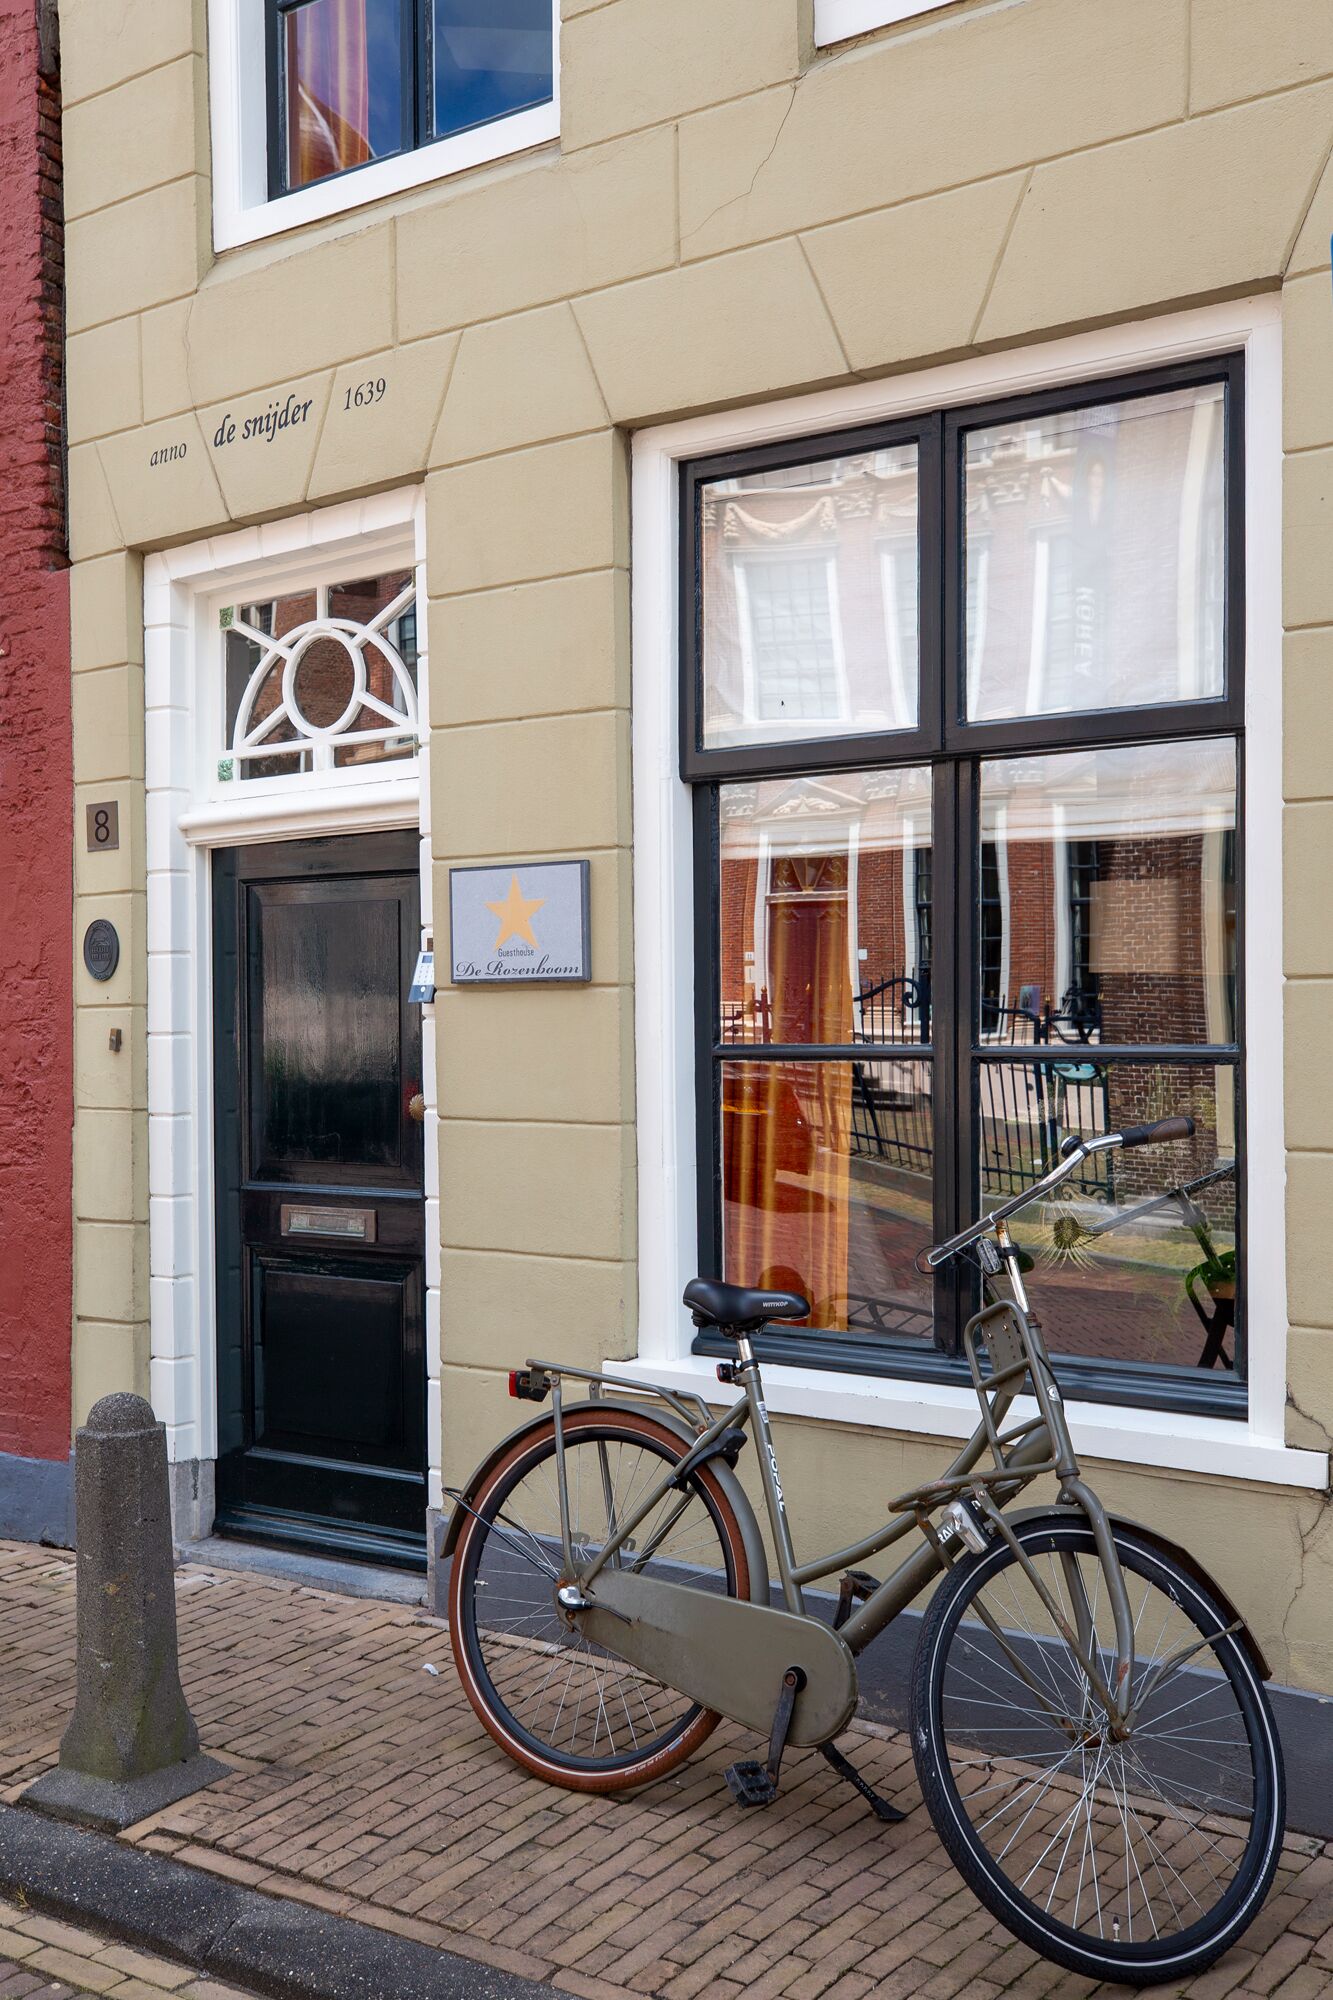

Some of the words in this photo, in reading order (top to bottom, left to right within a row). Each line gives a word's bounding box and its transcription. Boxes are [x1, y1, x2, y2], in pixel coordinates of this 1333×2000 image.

[150, 443, 187, 467] anno
[213, 414, 236, 448] de
[242, 394, 313, 443] snijder
[343, 378, 387, 411] 1639
[95, 809, 110, 843] 8
[455, 961, 481, 977] De
[485, 954, 579, 975] Rozenboom
[498, 948, 534, 958] Guesthouse
[767, 1444, 785, 1512] POPAL
